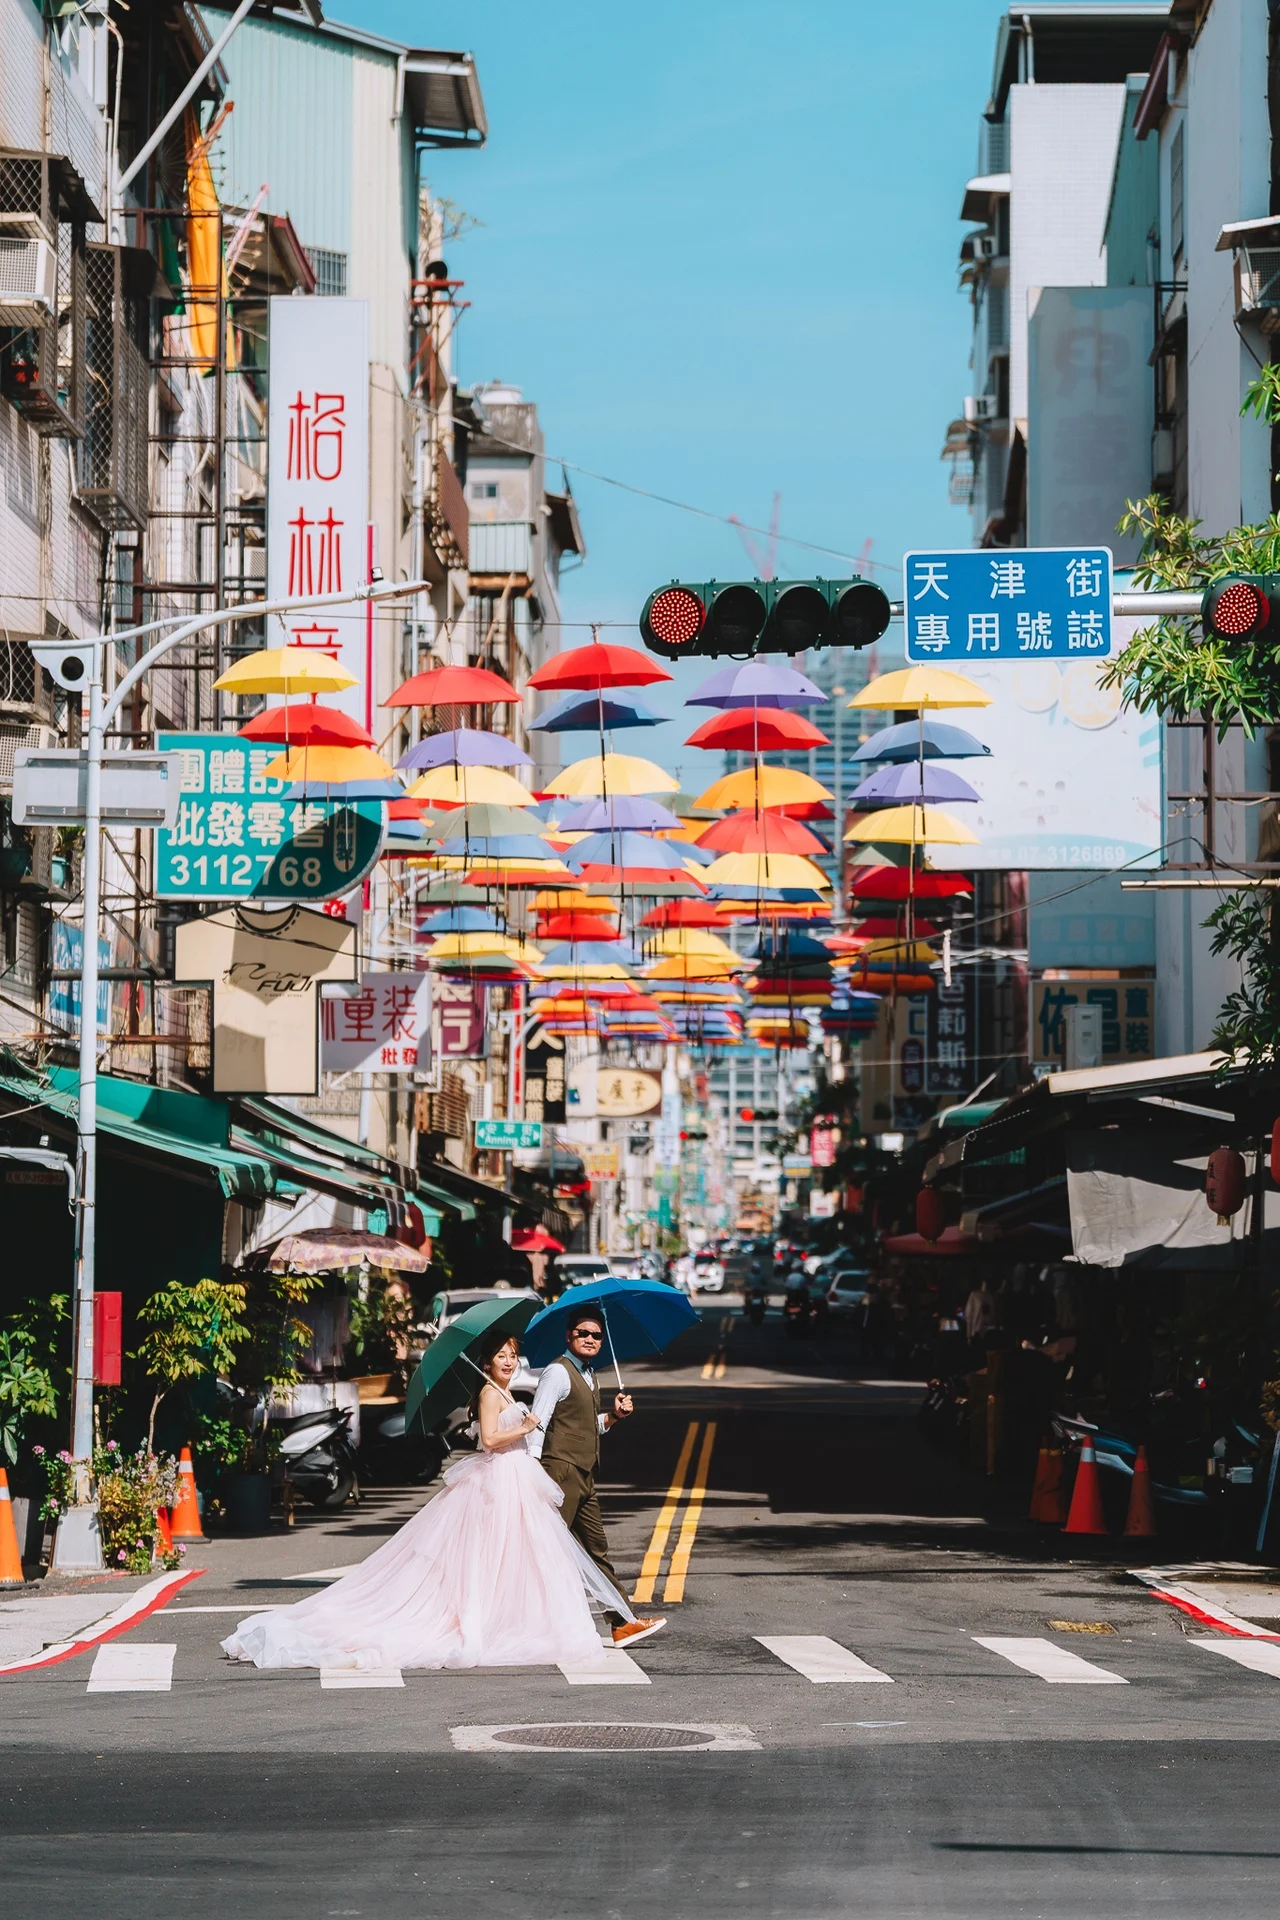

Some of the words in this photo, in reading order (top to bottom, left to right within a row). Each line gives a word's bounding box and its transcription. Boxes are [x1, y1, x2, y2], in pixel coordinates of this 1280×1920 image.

[914, 558, 1103, 601] 天津街
[914, 610, 1105, 653] 專用號誌
[180, 748, 297, 795] 團體訂
[166, 801, 326, 848] 批發零售
[169, 854, 322, 888] 3112768
[256, 976, 314, 992] FUJI
[485, 1134, 518, 1146] Anning
